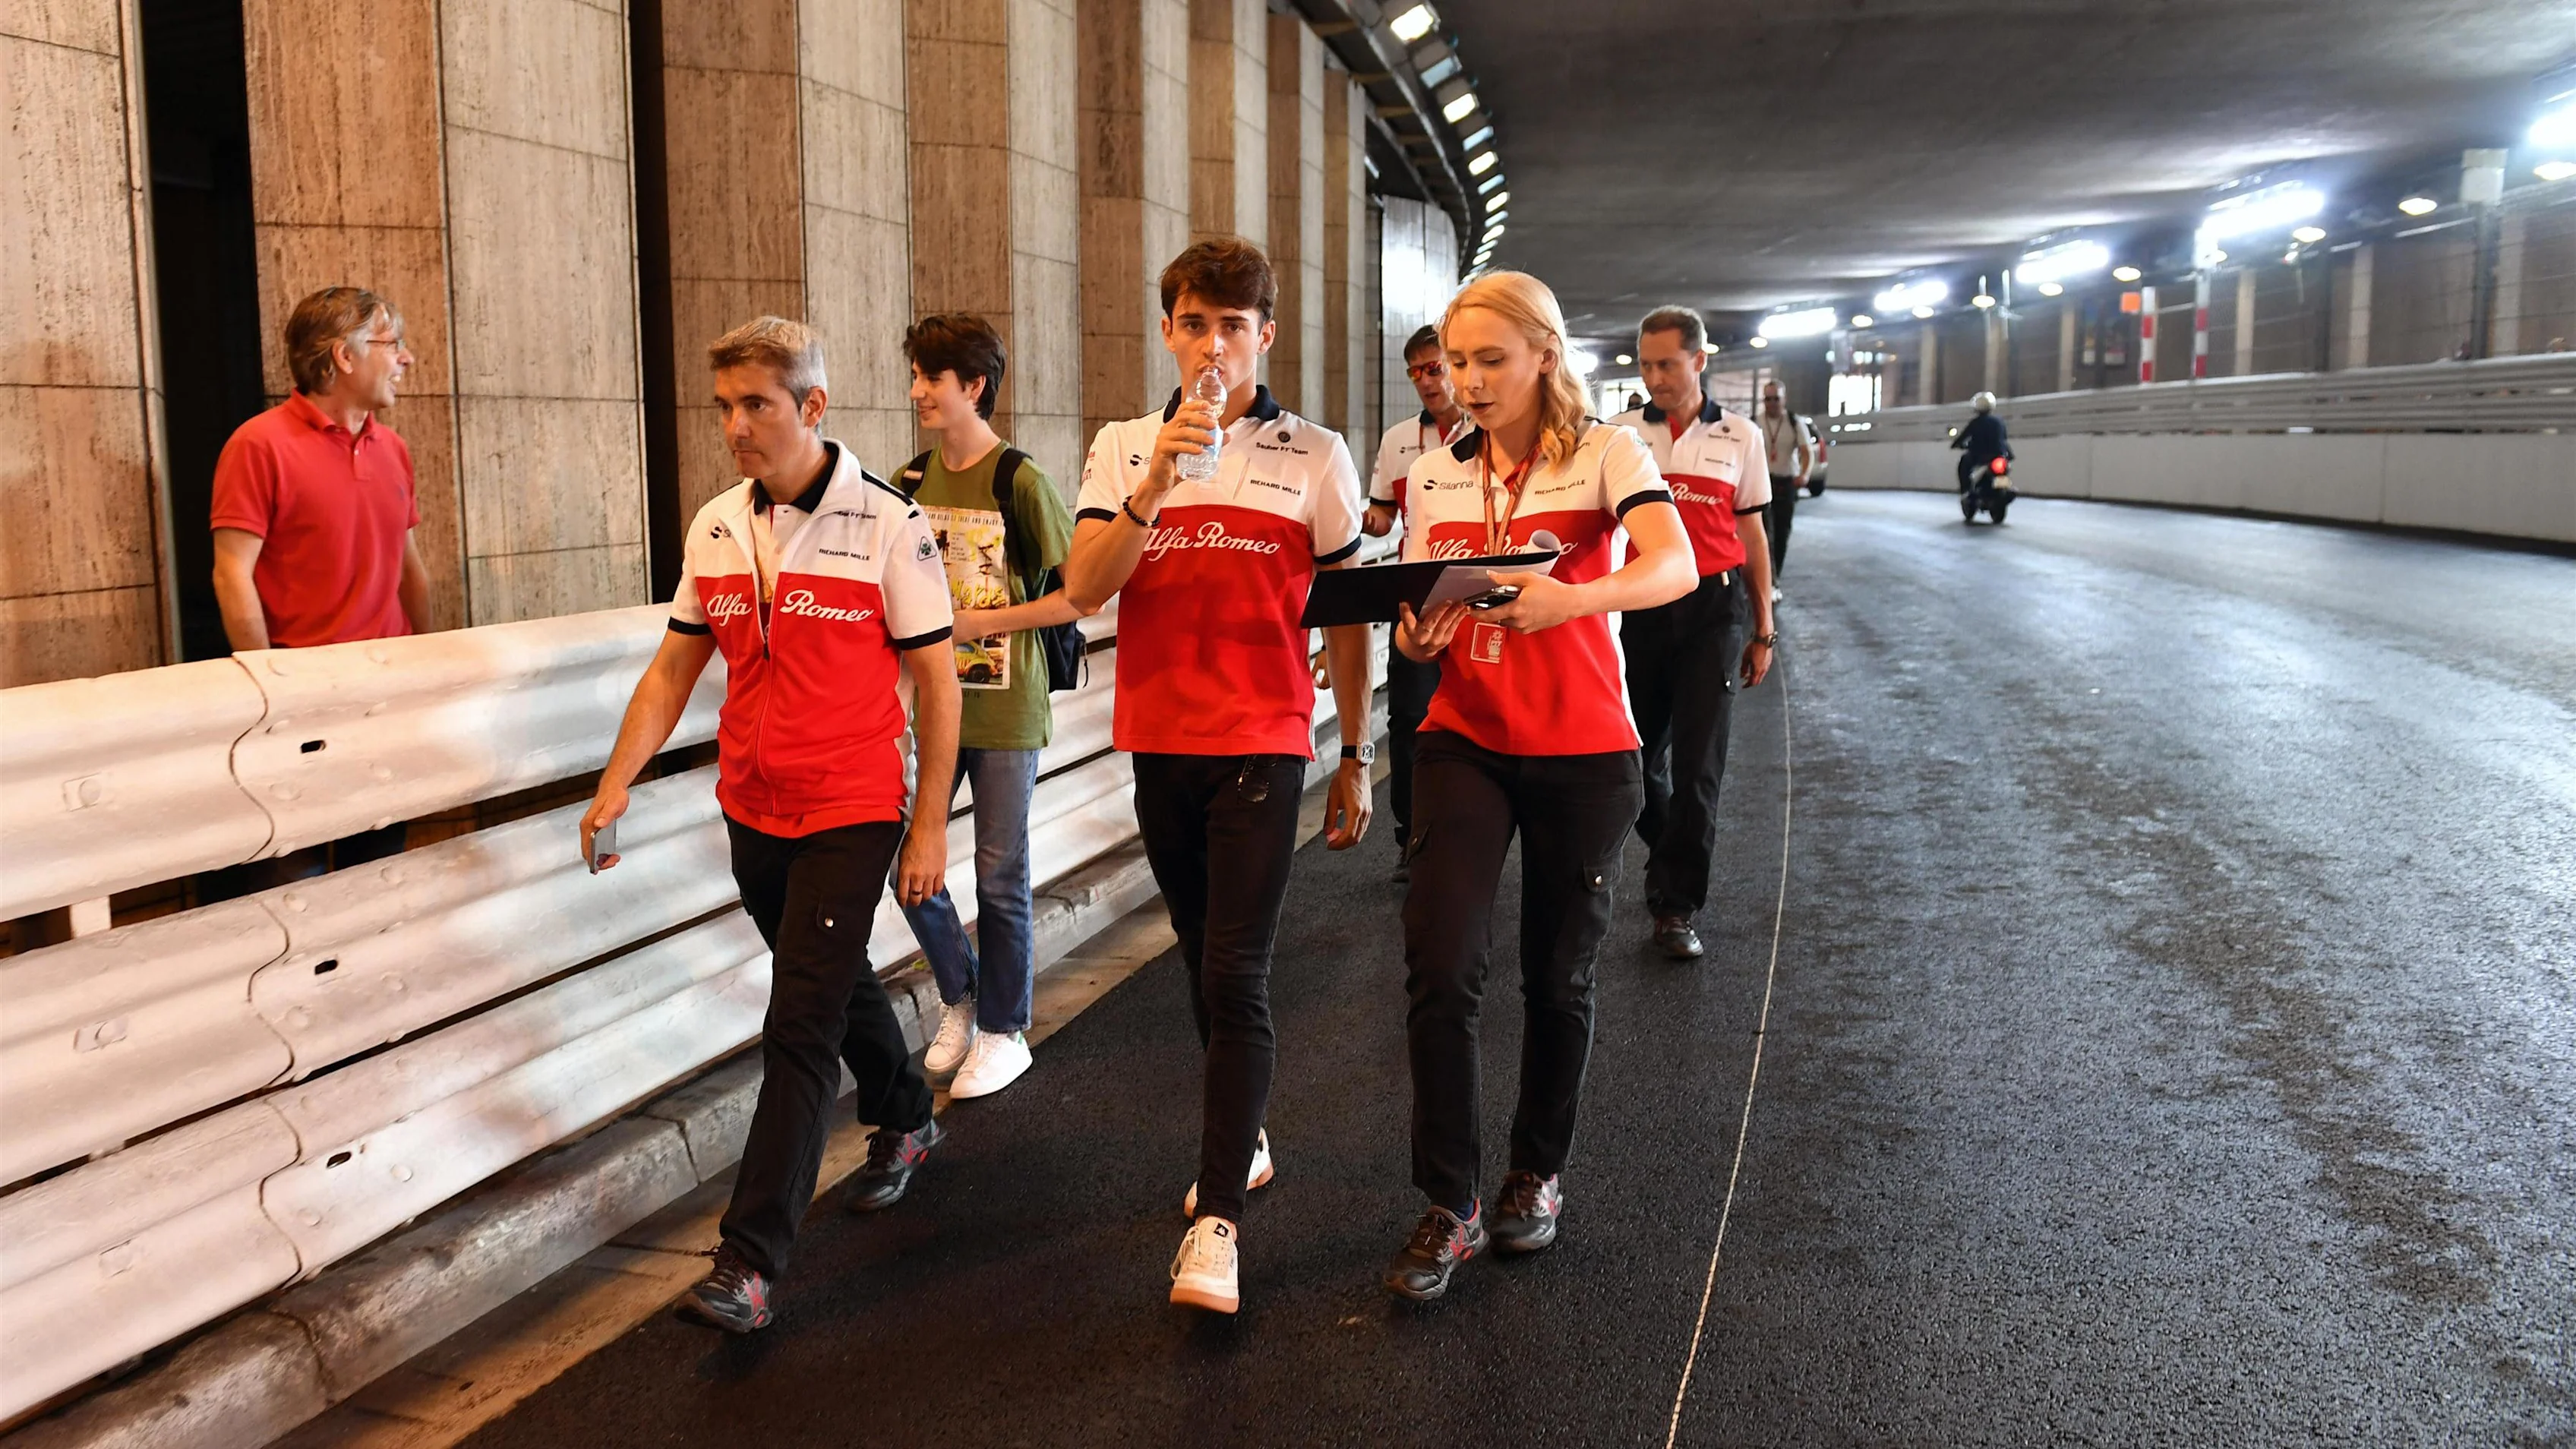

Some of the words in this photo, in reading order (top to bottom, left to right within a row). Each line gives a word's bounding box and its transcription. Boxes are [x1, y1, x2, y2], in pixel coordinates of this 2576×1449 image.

[1255, 442, 1279, 450] Sauber
[1290, 447, 1309, 456] Team
[1250, 479, 1280, 489] RICHARD
[1282, 486, 1301, 496] MILLE
[1439, 480, 1474, 490] Silanna
[1568, 479, 1586, 489] LLE
[1192, 521, 1281, 555] Romeo
[819, 548, 849, 557] RICHARD
[851, 552, 870, 561] MILLE
[706, 592, 753, 627] Alfa
[779, 588, 875, 623] Romeo
